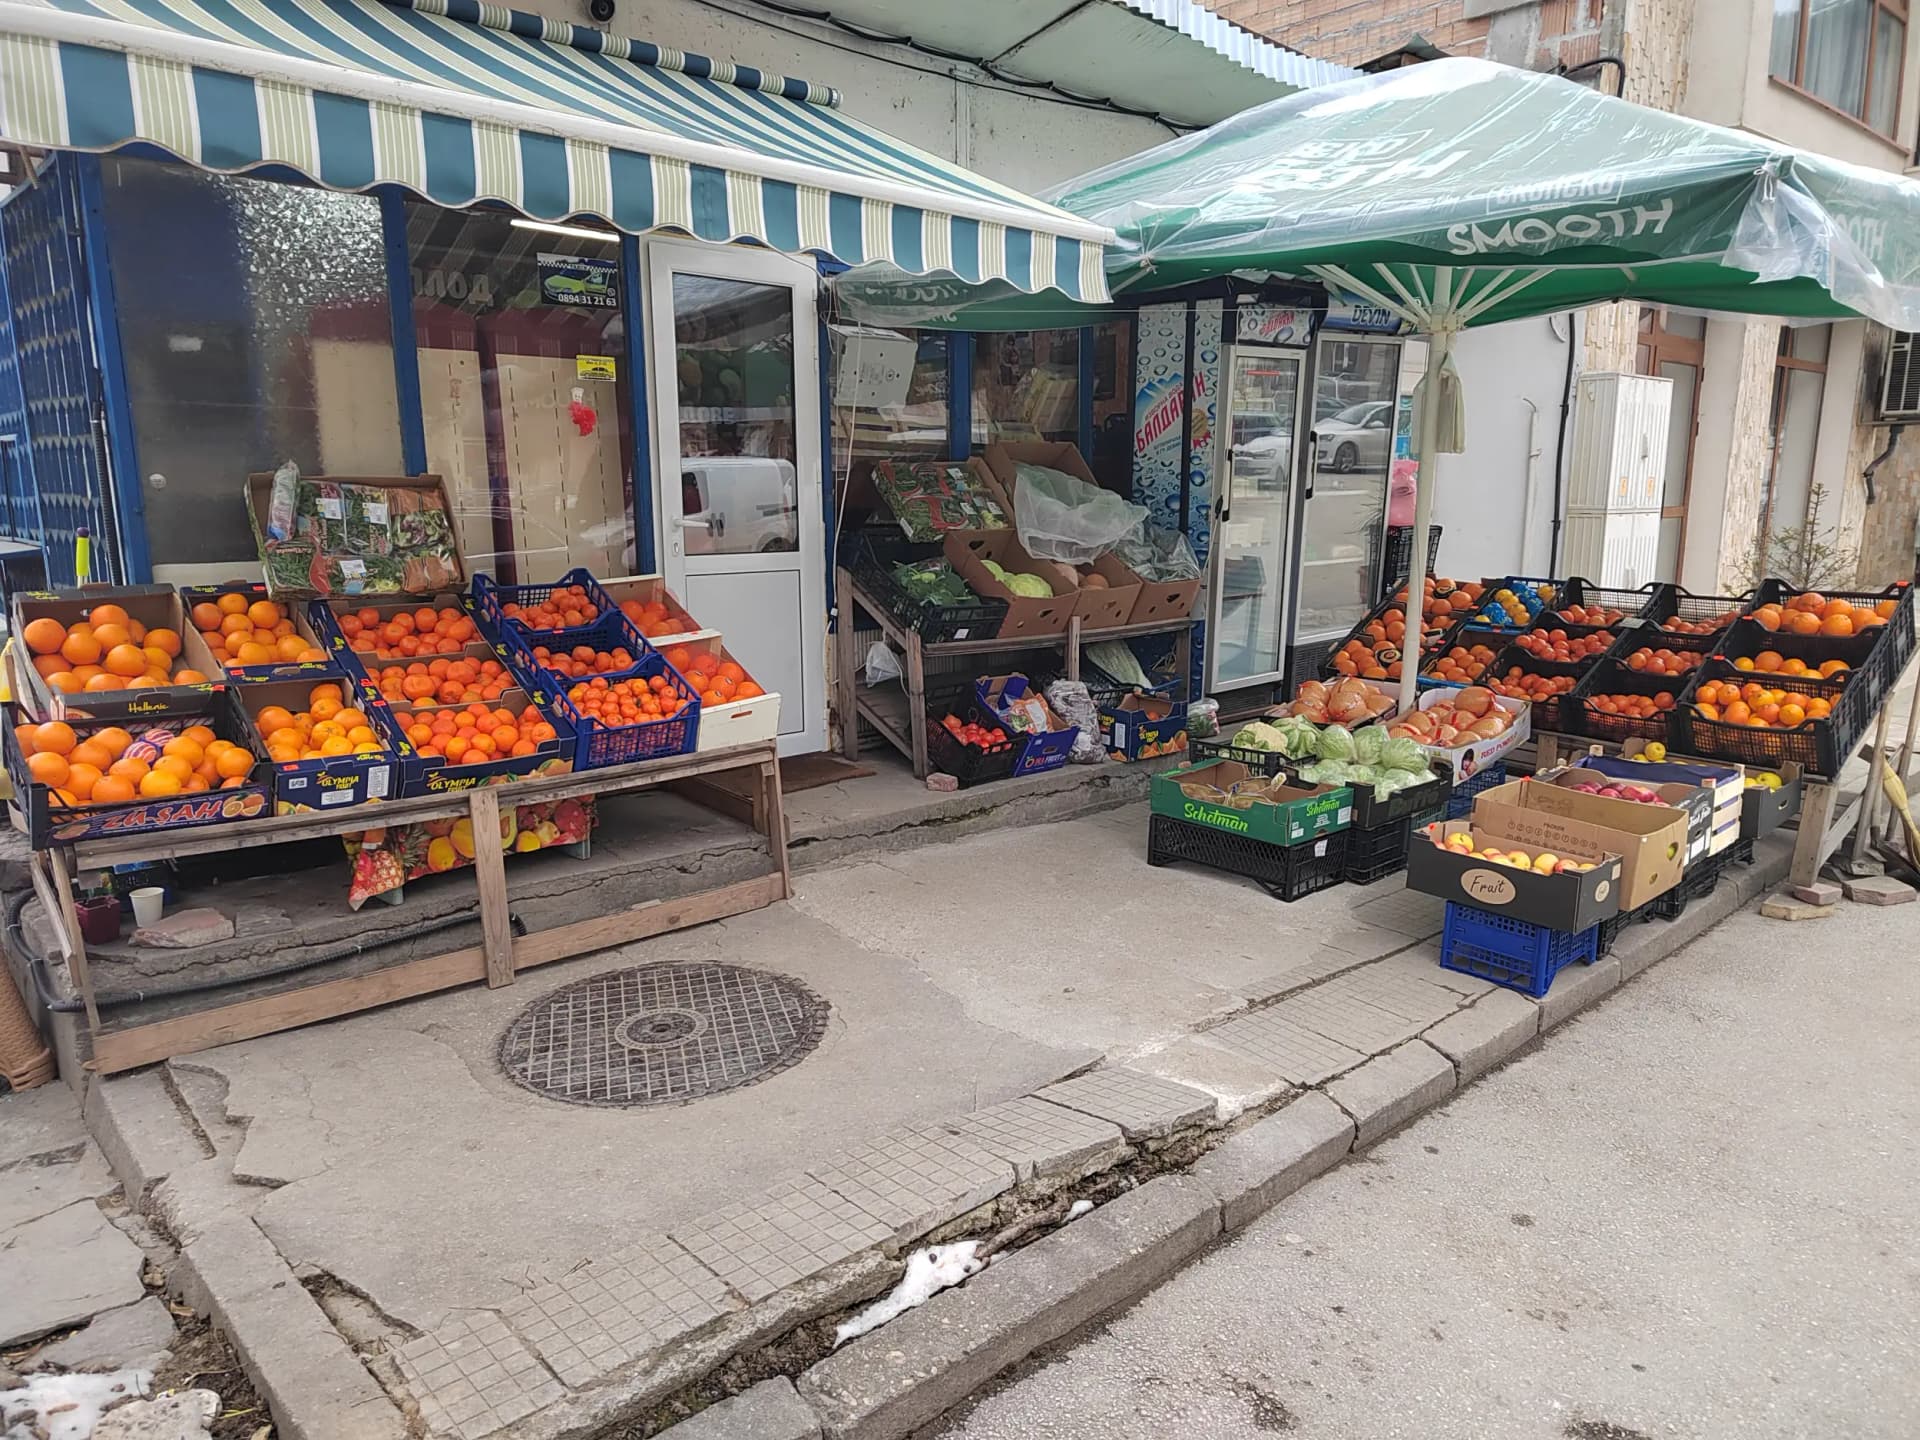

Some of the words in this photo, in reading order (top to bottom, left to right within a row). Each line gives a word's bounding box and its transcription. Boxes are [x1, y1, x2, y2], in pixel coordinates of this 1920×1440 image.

[1447, 199, 1674, 256] SMOOTH
[558, 294, 580, 304] 0894
[581, 295, 593, 305] 31
[594, 296, 605, 306] 21
[606, 297, 617, 307] 63
[1351, 304, 1391, 327] DEVIN
[1136, 371, 1206, 453] БАЛДАРН
[321, 775, 360, 787] OLYMPIA
[431, 777, 476, 791] OLYMPIA
[1470, 874, 1505, 895] Fruit
